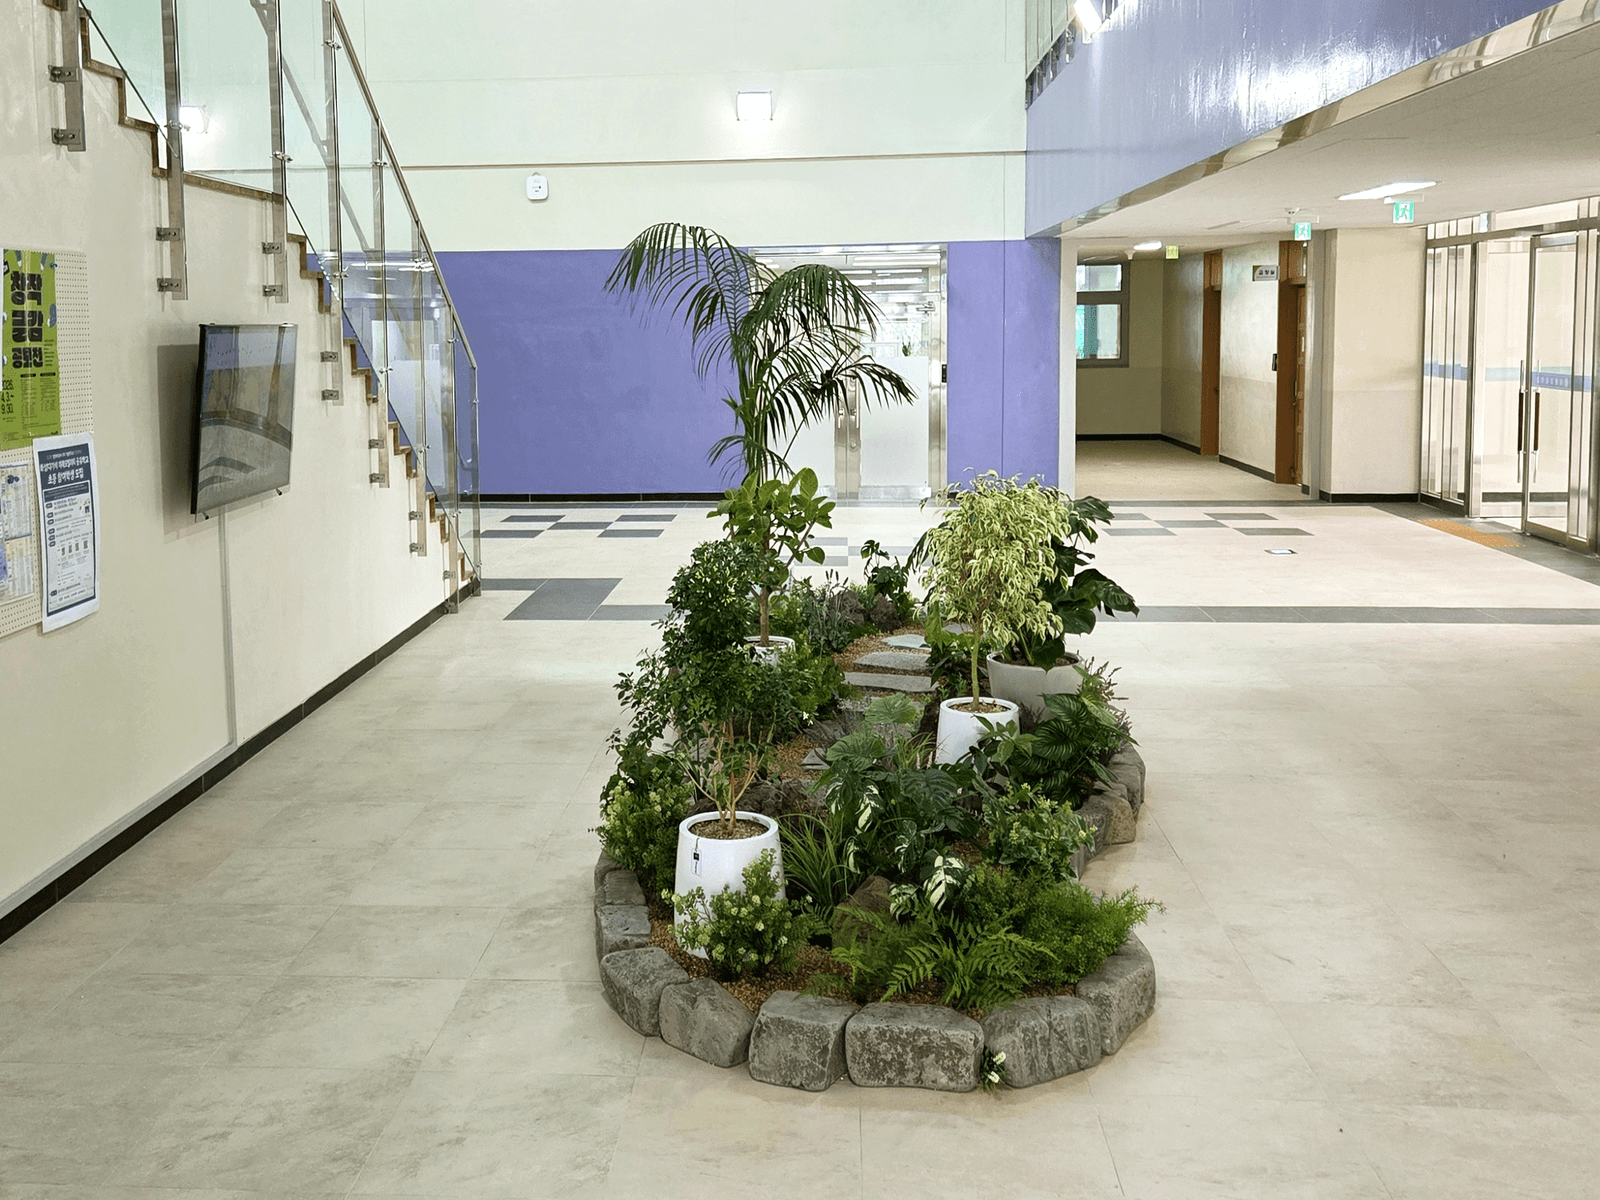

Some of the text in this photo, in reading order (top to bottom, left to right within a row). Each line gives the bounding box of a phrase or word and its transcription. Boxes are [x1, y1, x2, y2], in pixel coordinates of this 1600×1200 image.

[11, 271, 42, 306] 창작
[12, 309, 43, 343] 글감
[12, 346, 43, 369] 공모전
[75, 467, 84, 479] 모집
